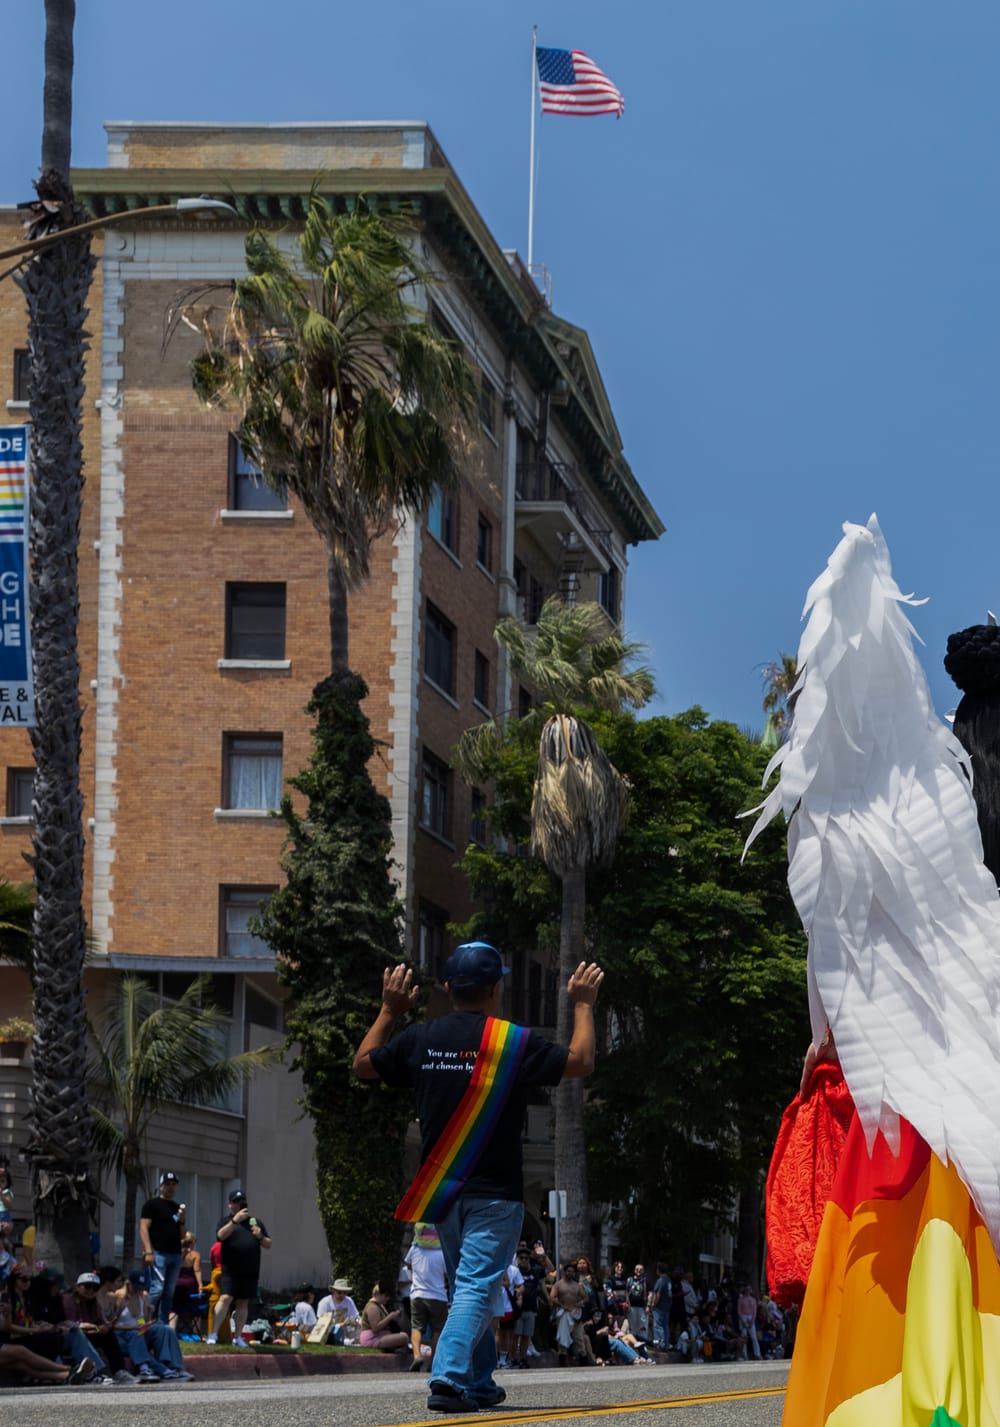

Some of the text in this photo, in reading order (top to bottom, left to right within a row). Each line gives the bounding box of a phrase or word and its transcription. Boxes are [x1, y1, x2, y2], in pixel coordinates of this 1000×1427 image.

[0, 624, 21, 647] E
[0, 705, 28, 722] AL
[427, 1049, 443, 1057] You
[421, 1061, 474, 1073] and chosen by
